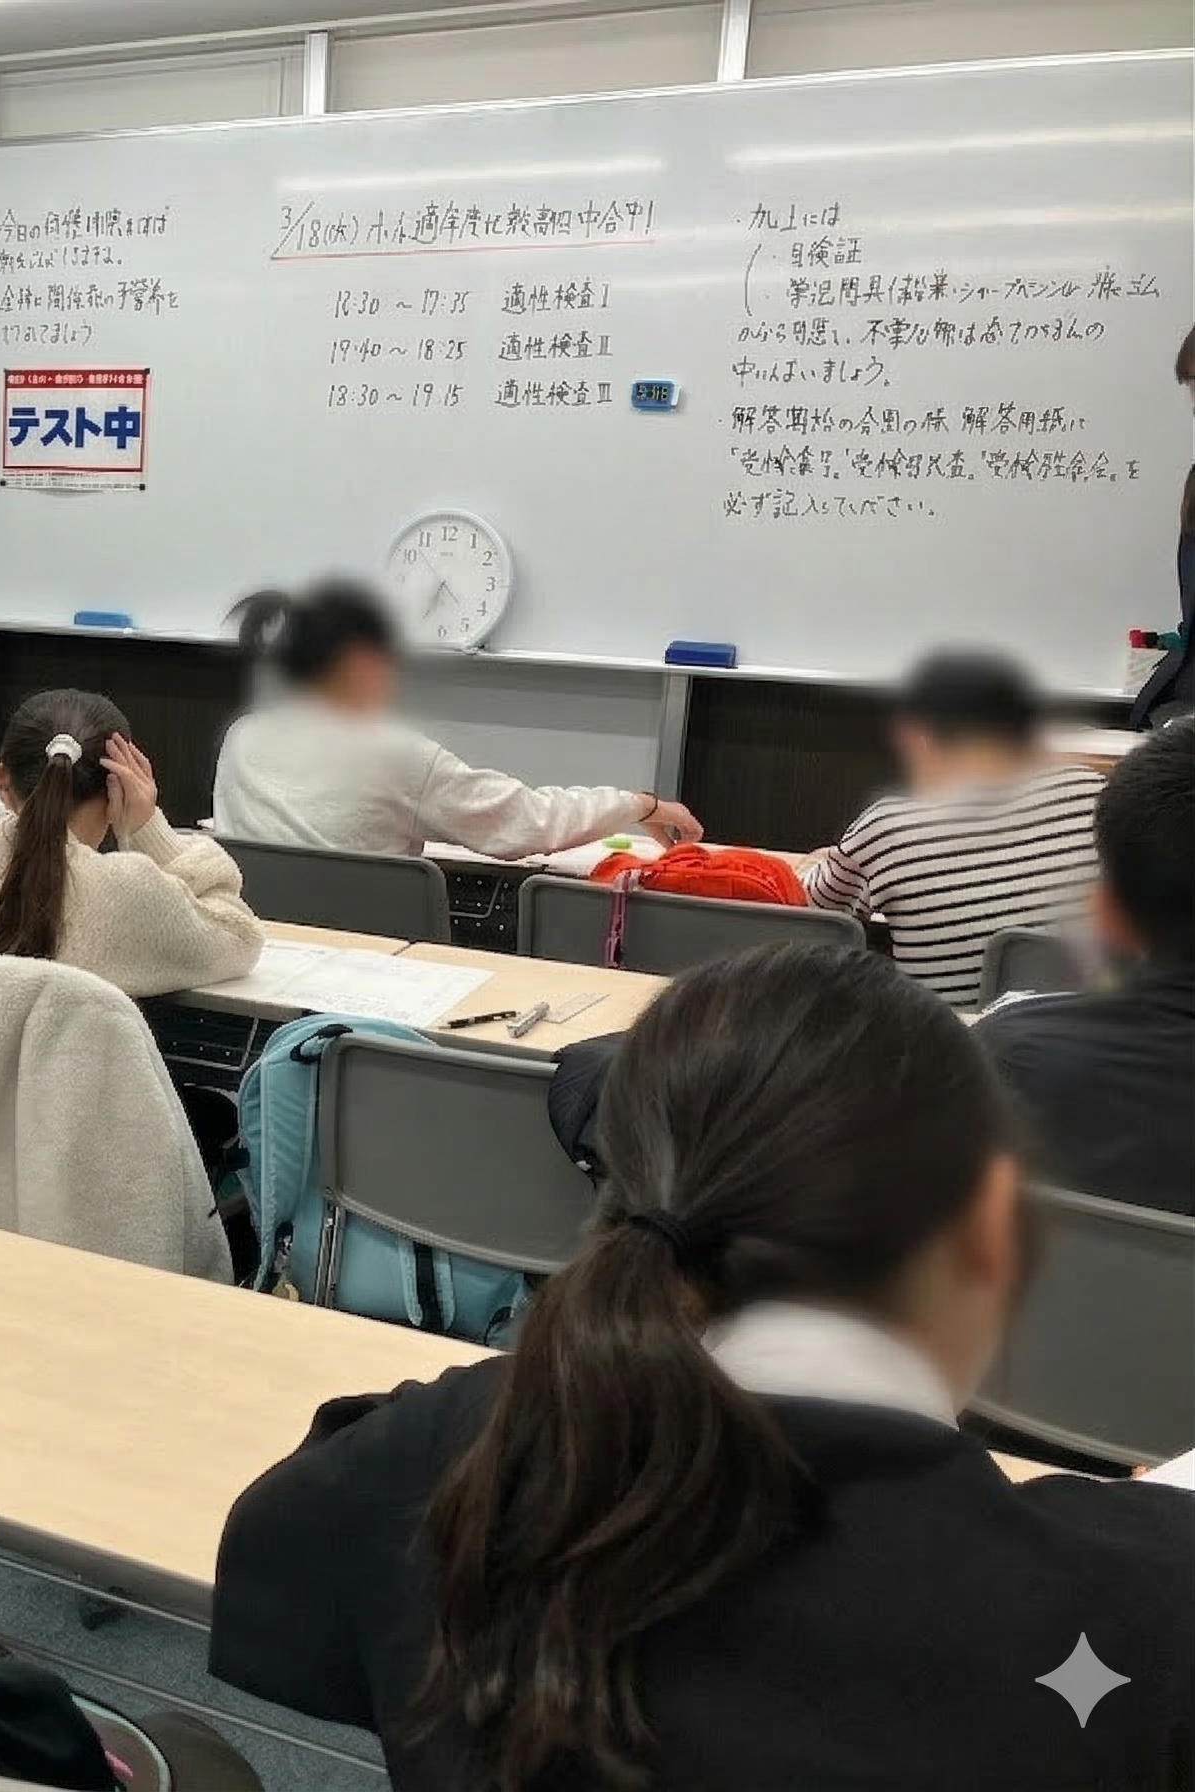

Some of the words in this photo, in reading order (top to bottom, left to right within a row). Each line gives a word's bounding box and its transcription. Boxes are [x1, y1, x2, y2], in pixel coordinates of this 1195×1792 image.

[8, 405, 141, 449] テスト中
[418, 531, 431, 548] 11
[442, 526, 458, 541] 12
[470, 533, 477, 549] 1
[482, 551, 493, 566] 2
[485, 576, 496, 592] 3
[476, 600, 487, 617] 4
